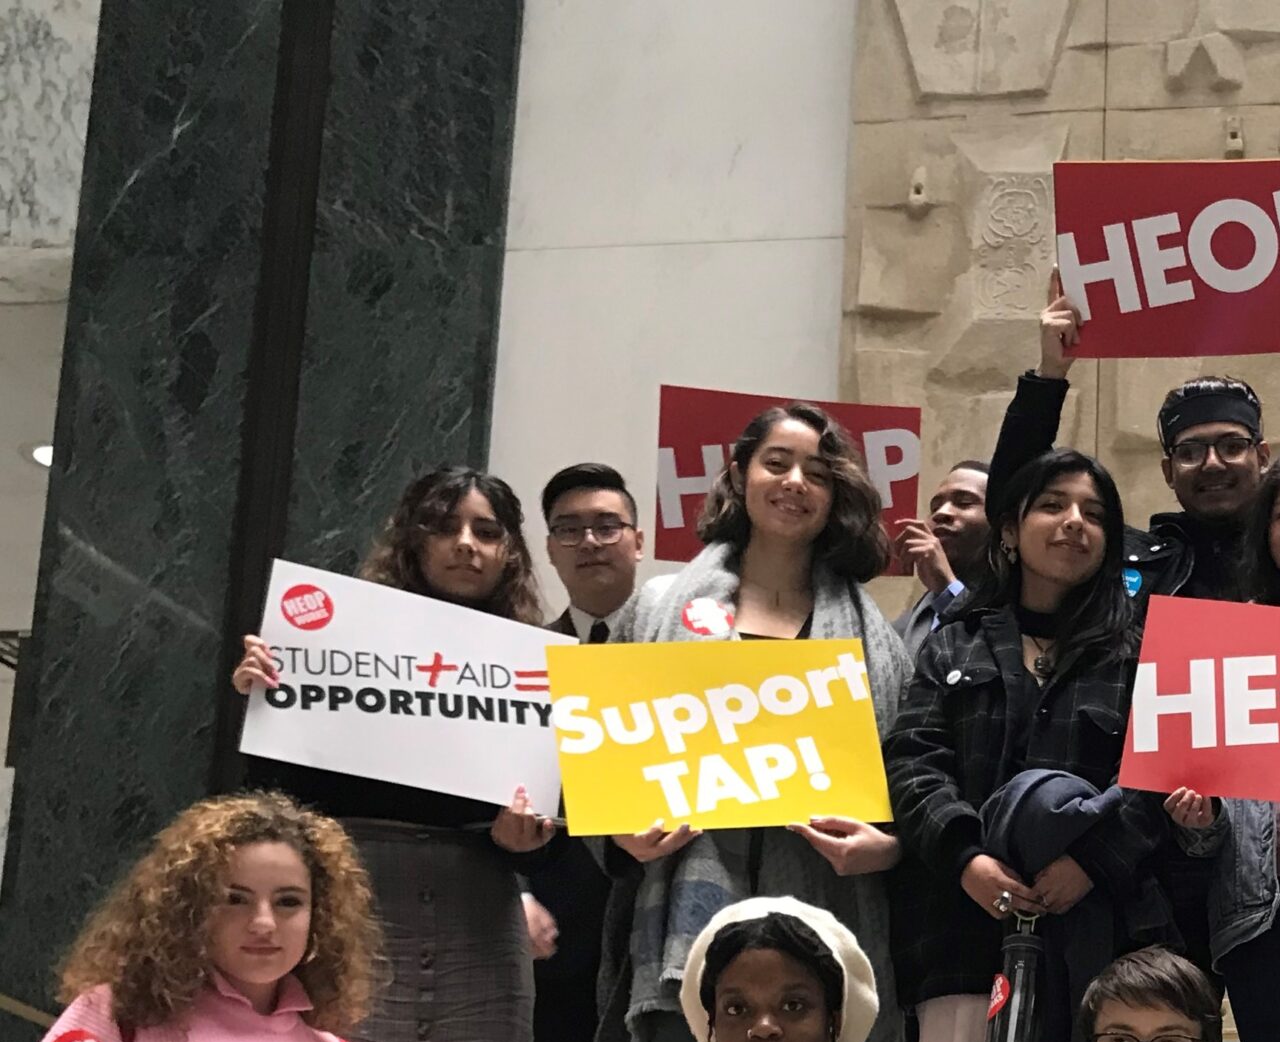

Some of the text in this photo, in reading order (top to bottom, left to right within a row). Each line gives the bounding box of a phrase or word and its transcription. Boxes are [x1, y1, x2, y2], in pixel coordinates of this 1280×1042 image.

[657, 428, 920, 529] HP
[283, 590, 326, 617] HEOP
[264, 684, 553, 727] OPPORTUNITY
[552, 653, 869, 754] Support
[642, 736, 832, 818] TAP!
